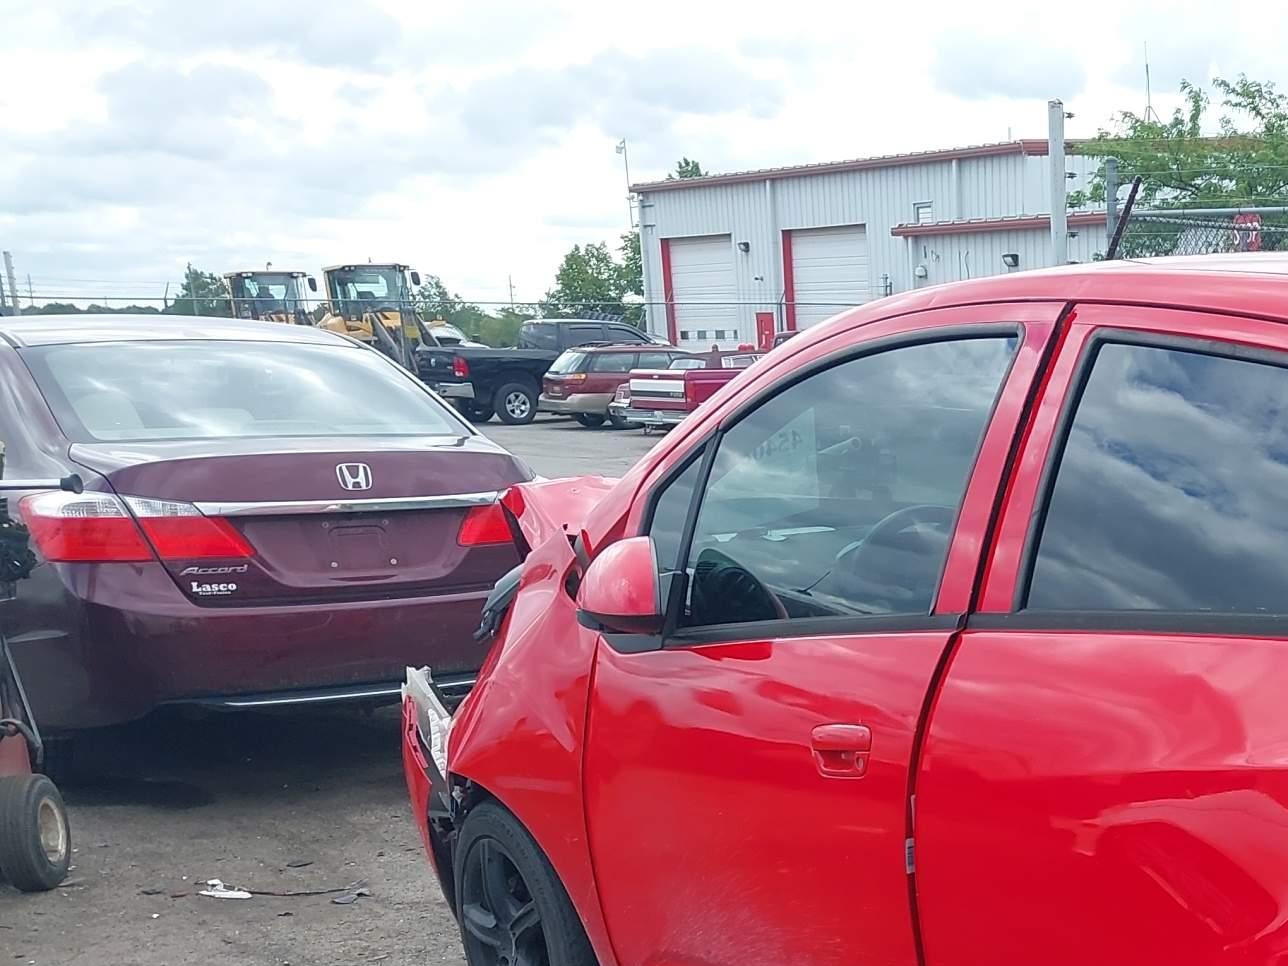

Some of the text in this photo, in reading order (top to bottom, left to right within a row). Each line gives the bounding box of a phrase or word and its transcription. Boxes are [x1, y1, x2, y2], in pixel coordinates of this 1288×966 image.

[1233, 221, 1260, 245] SOP
[180, 564, 248, 576] Accord
[191, 582, 237, 592] Lasco
